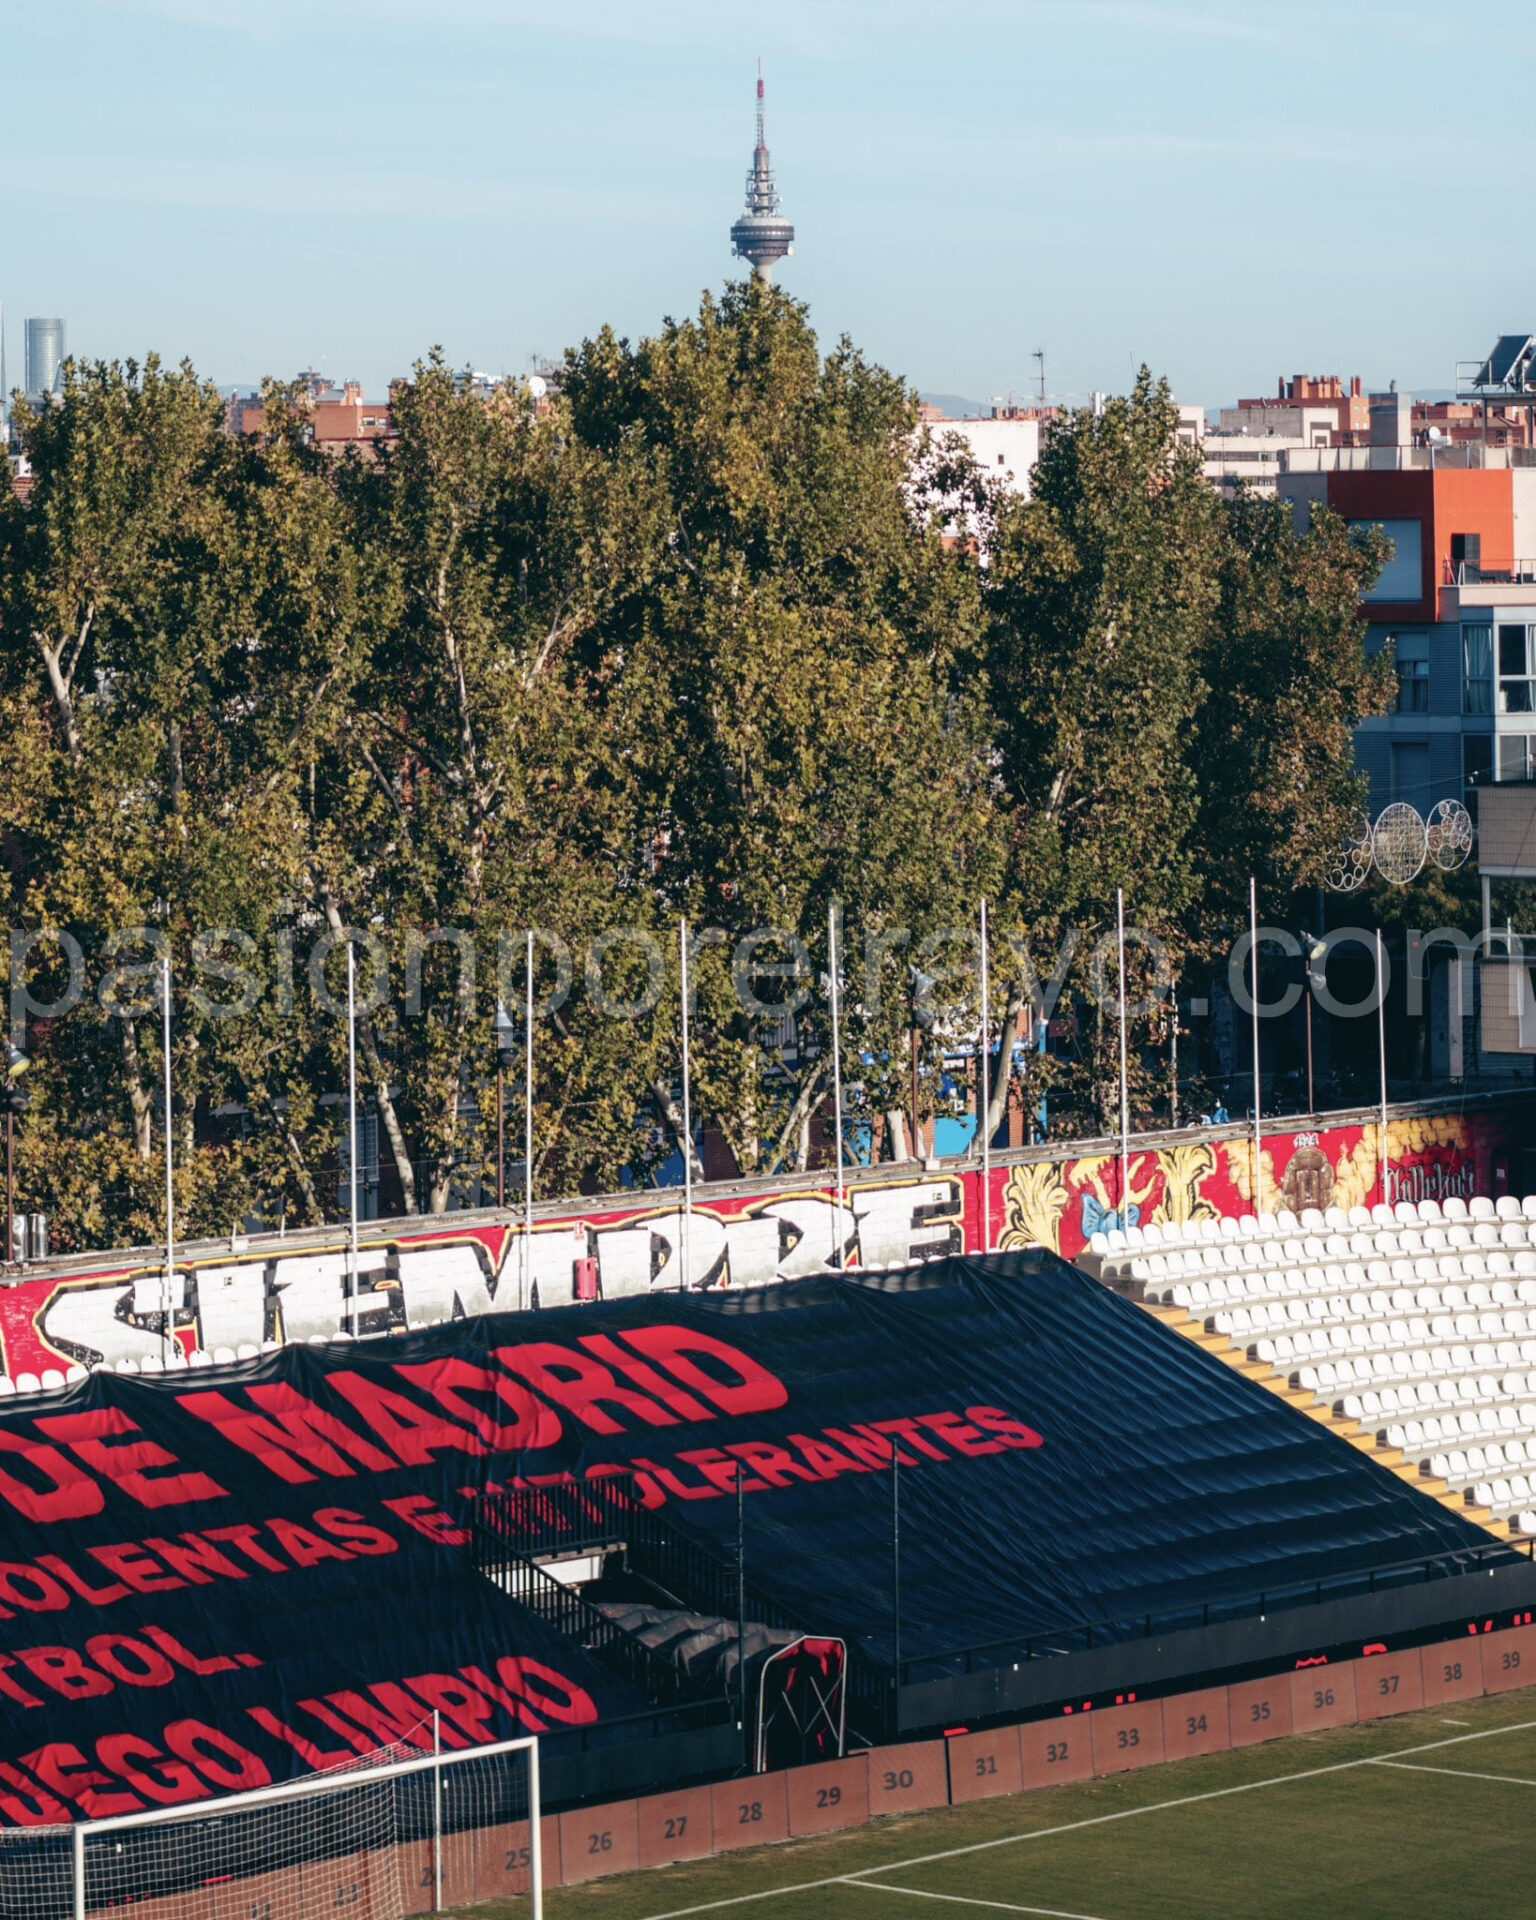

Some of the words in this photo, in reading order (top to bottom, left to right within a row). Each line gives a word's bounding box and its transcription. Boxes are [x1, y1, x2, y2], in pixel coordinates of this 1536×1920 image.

[0, 1406, 231, 1523] DE
[175, 1324, 788, 1484] MADRID
[0, 1507, 398, 1620] OLENTAS
[1501, 1650, 1522, 1670] 39
[1443, 1662, 1463, 1683] 38
[1379, 1675, 1400, 1696] 37
[1314, 1688, 1335, 1709] 36
[246, 1656, 599, 1772] LIMPIO
[1251, 1701, 1271, 1722] 35
[1186, 1714, 1208, 1735] 34
[1117, 1728, 1140, 1749] 33
[1046, 1741, 1069, 1763] 32
[976, 1754, 998, 1776] 31
[883, 1769, 914, 1790] 30
[816, 1786, 841, 1808] 29
[738, 1802, 763, 1824] 28
[664, 1816, 688, 1839] 27
[588, 1831, 613, 1854] 26
[505, 1850, 531, 1871] 25
